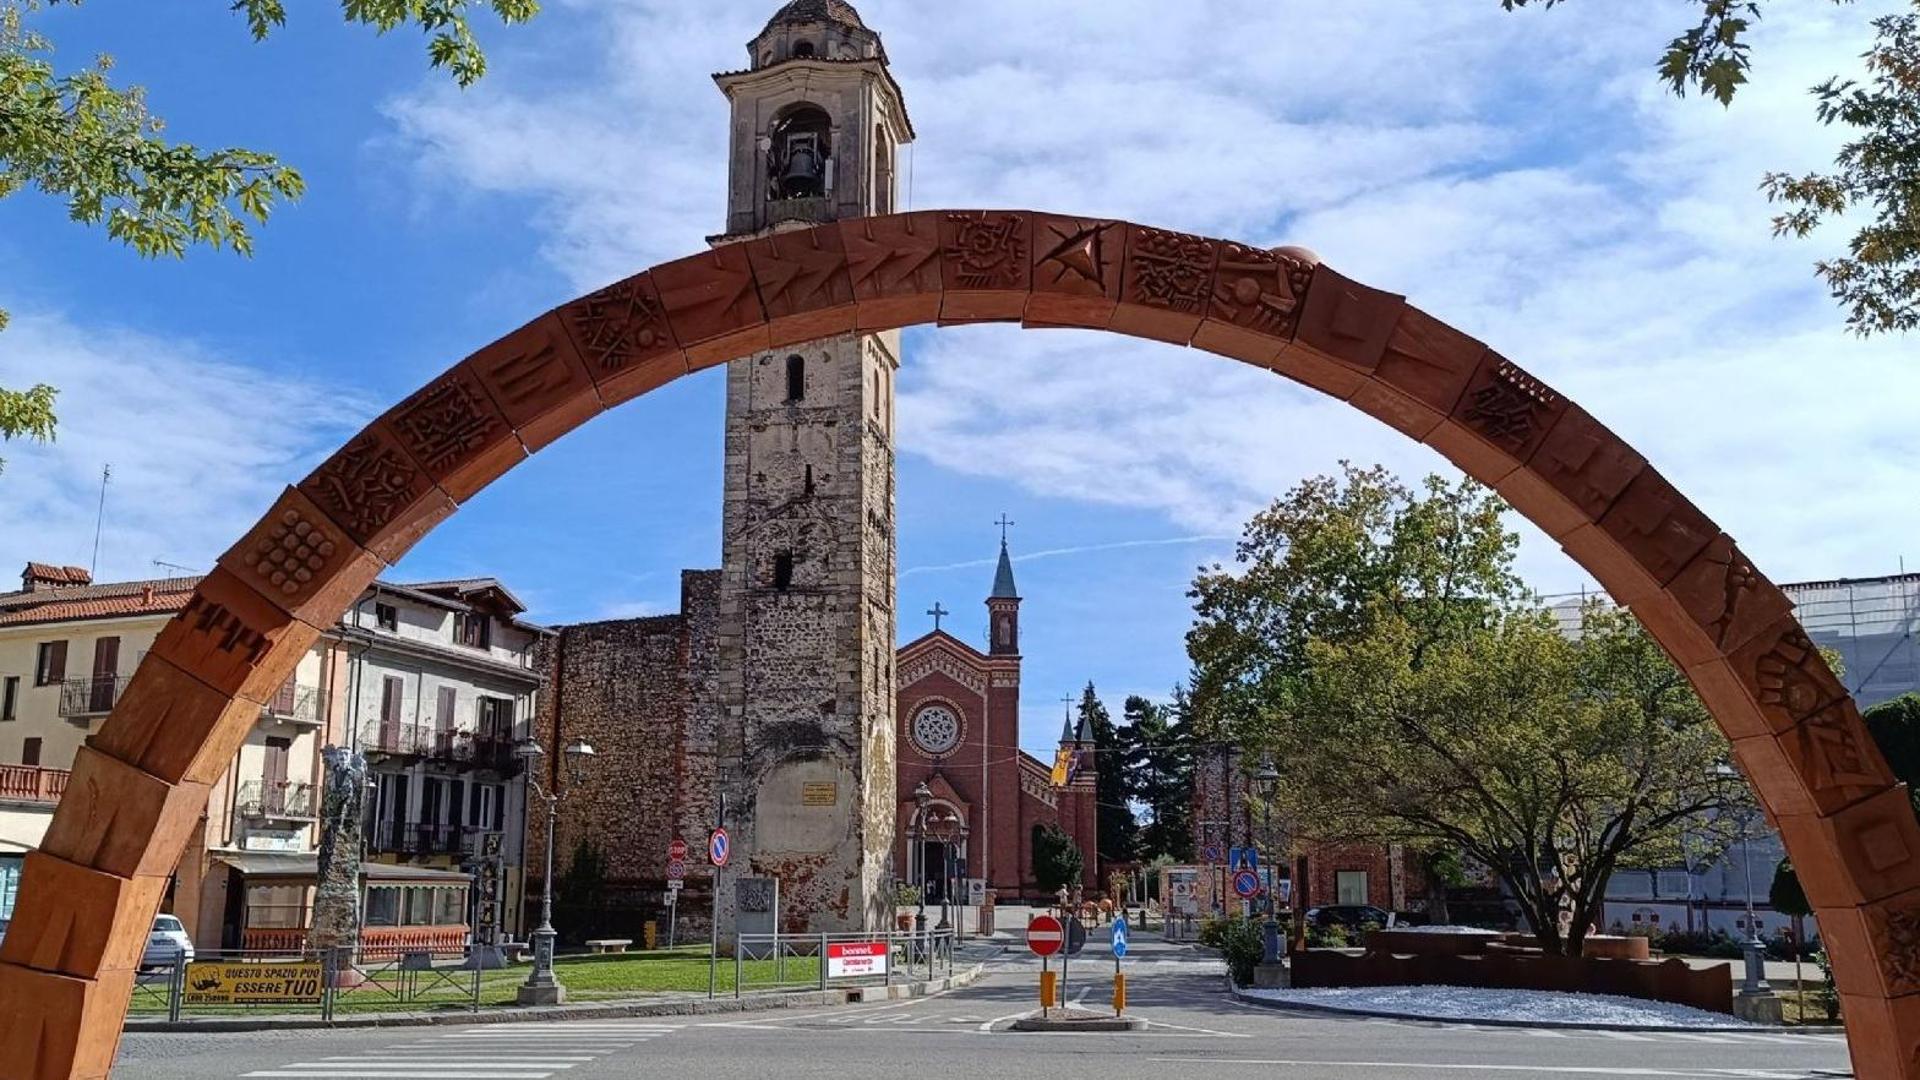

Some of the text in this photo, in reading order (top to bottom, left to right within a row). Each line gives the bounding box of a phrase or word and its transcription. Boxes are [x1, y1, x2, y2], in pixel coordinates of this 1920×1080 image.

[669, 846, 685, 854] STOP
[225, 968, 262, 978] QUESTO
[264, 968, 297, 978] SPAZIO
[235, 980, 318, 995] ESSERE TUO
